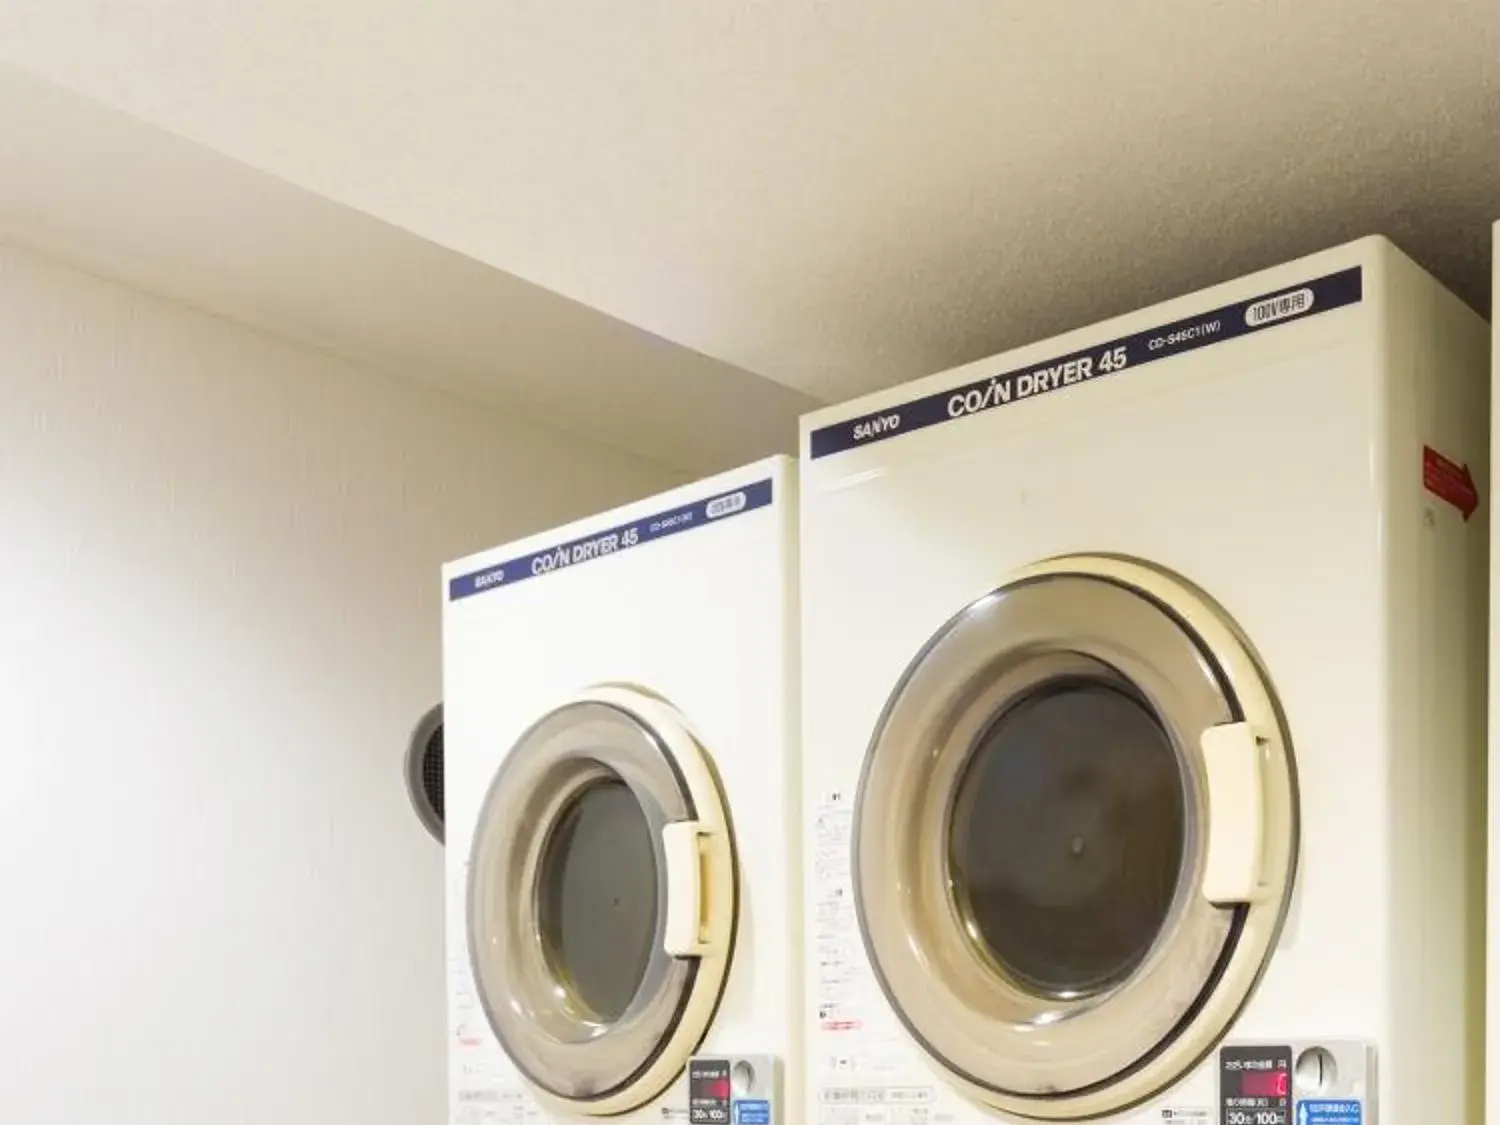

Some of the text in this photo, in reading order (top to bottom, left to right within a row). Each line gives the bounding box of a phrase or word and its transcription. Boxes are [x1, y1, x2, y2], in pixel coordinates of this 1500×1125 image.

[1252, 292, 1305, 323] 100V専用
[946, 346, 1127, 418] COIN DRYER 45
[853, 414, 900, 441] SANYO
[531, 527, 639, 576] COIN DRYER 45
